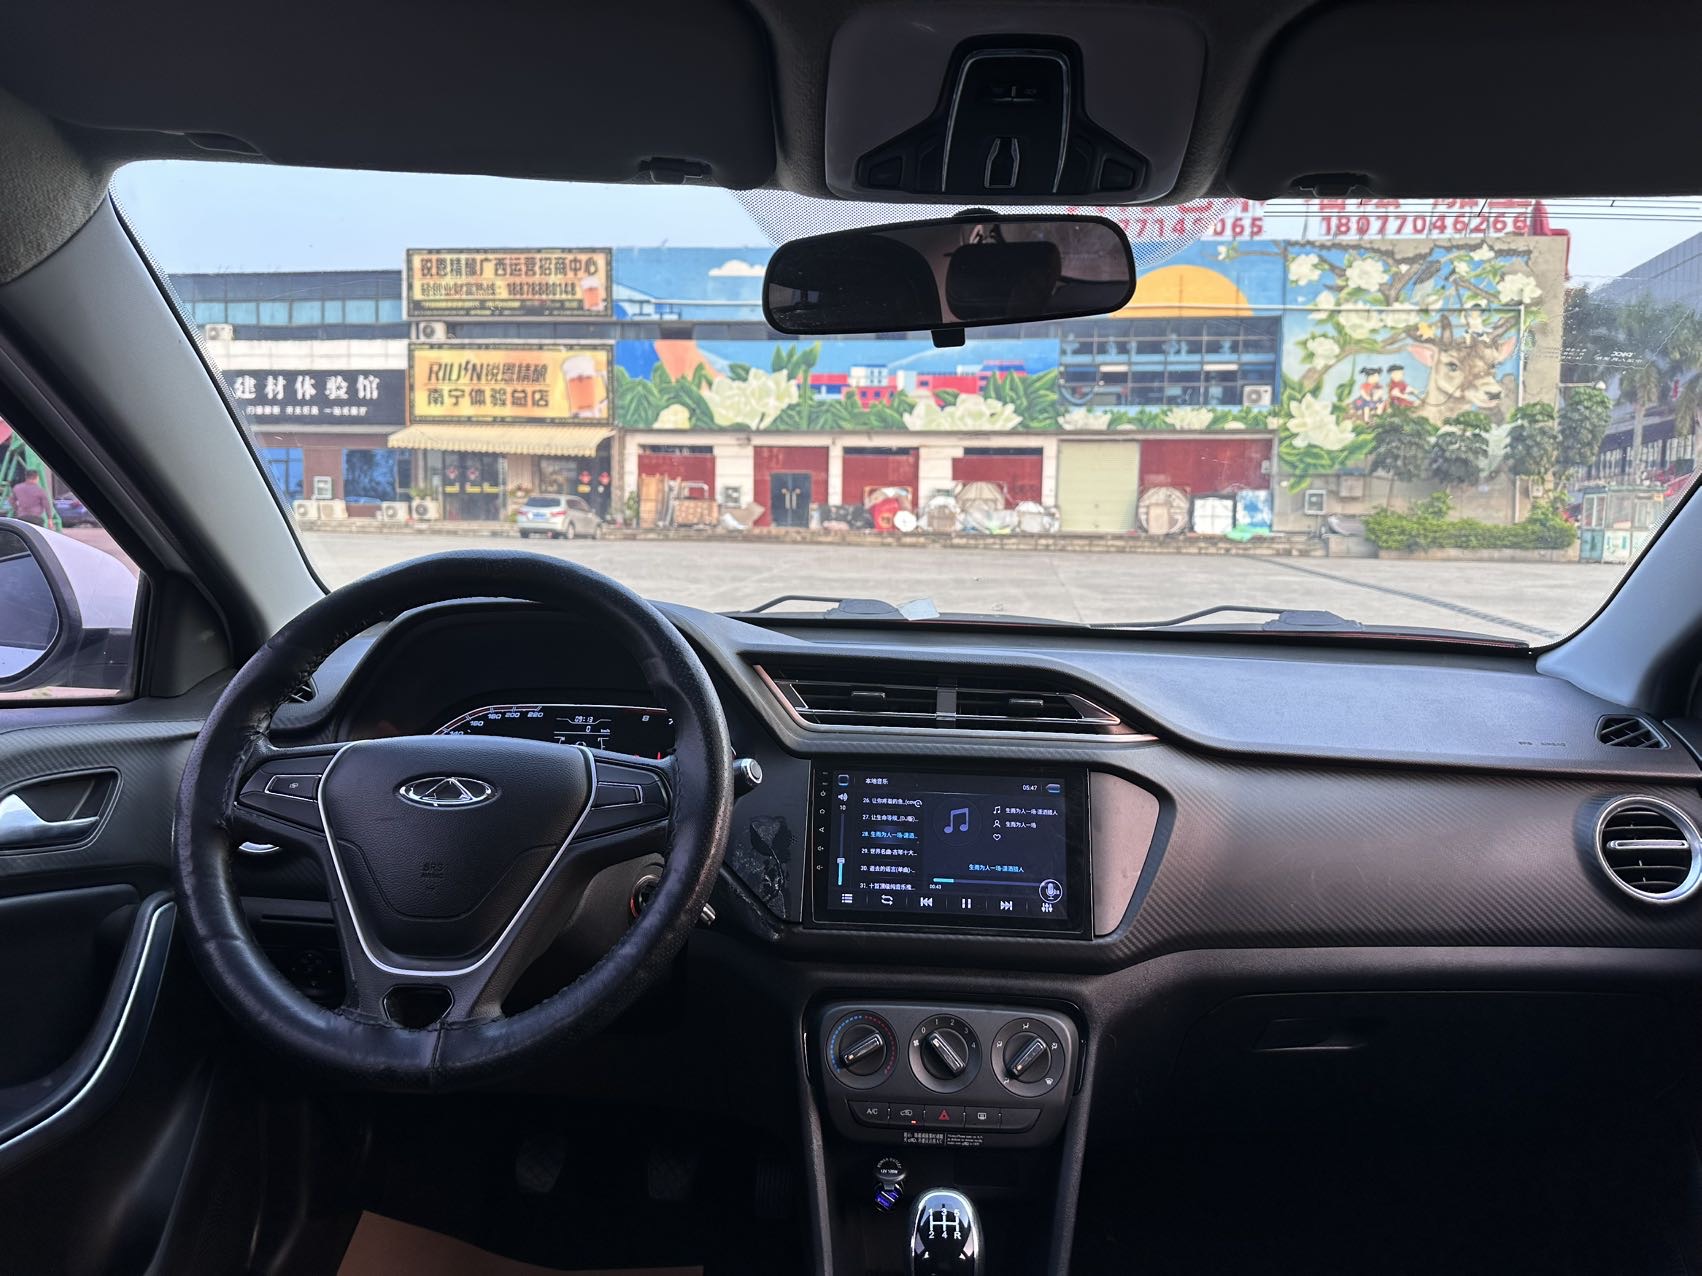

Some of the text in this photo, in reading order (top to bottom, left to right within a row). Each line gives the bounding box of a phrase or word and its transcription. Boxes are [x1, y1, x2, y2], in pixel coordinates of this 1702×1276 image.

[1321, 214, 1528, 236] 18077046266
[233, 374, 380, 400] 建材体验馆
[921, 1026, 926, 1034] 0
[971, 1041, 976, 1049] 4
[941, 1207, 947, 1216] 3
[928, 1231, 961, 1240] 2 4 R
